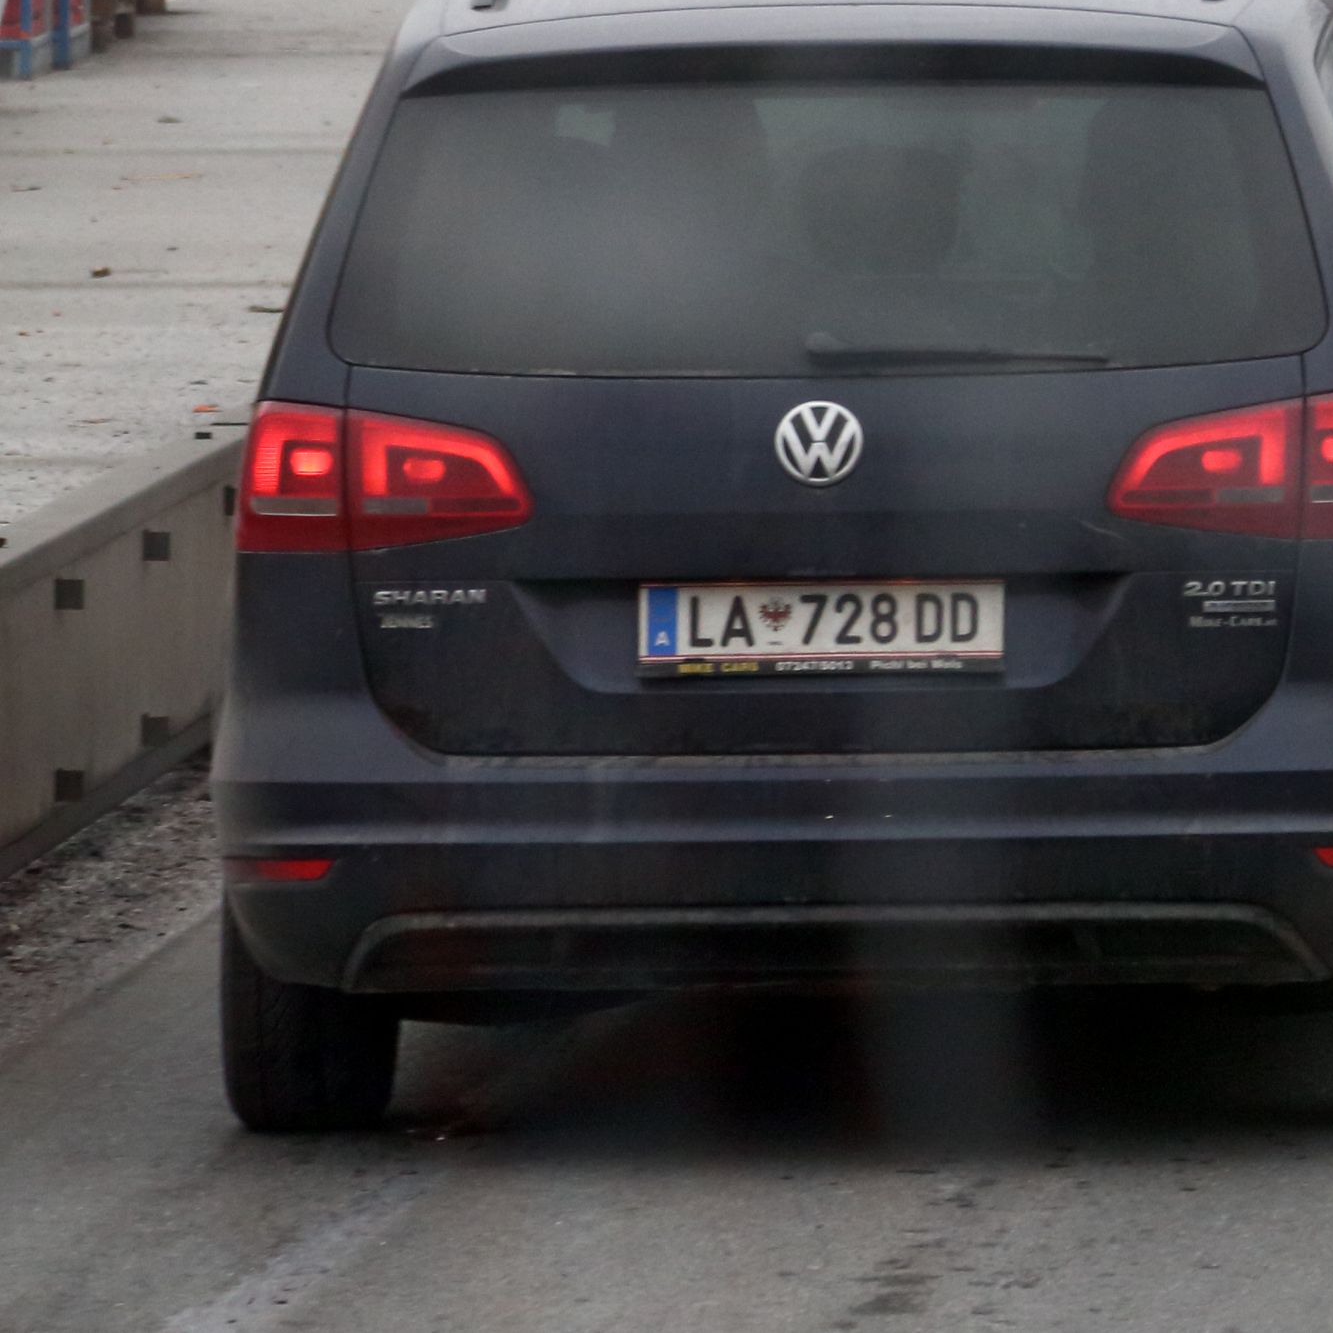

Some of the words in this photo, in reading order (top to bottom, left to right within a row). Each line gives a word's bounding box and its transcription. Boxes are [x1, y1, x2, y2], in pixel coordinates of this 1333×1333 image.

[373, 588, 487, 606] SHARAN
[1183, 580, 1226, 597] 2.0
[1230, 580, 1276, 597] TDI
[689, 594, 755, 649] LA
[799, 593, 898, 646] 728
[915, 592, 979, 645] DD
[653, 630, 670, 647] A
